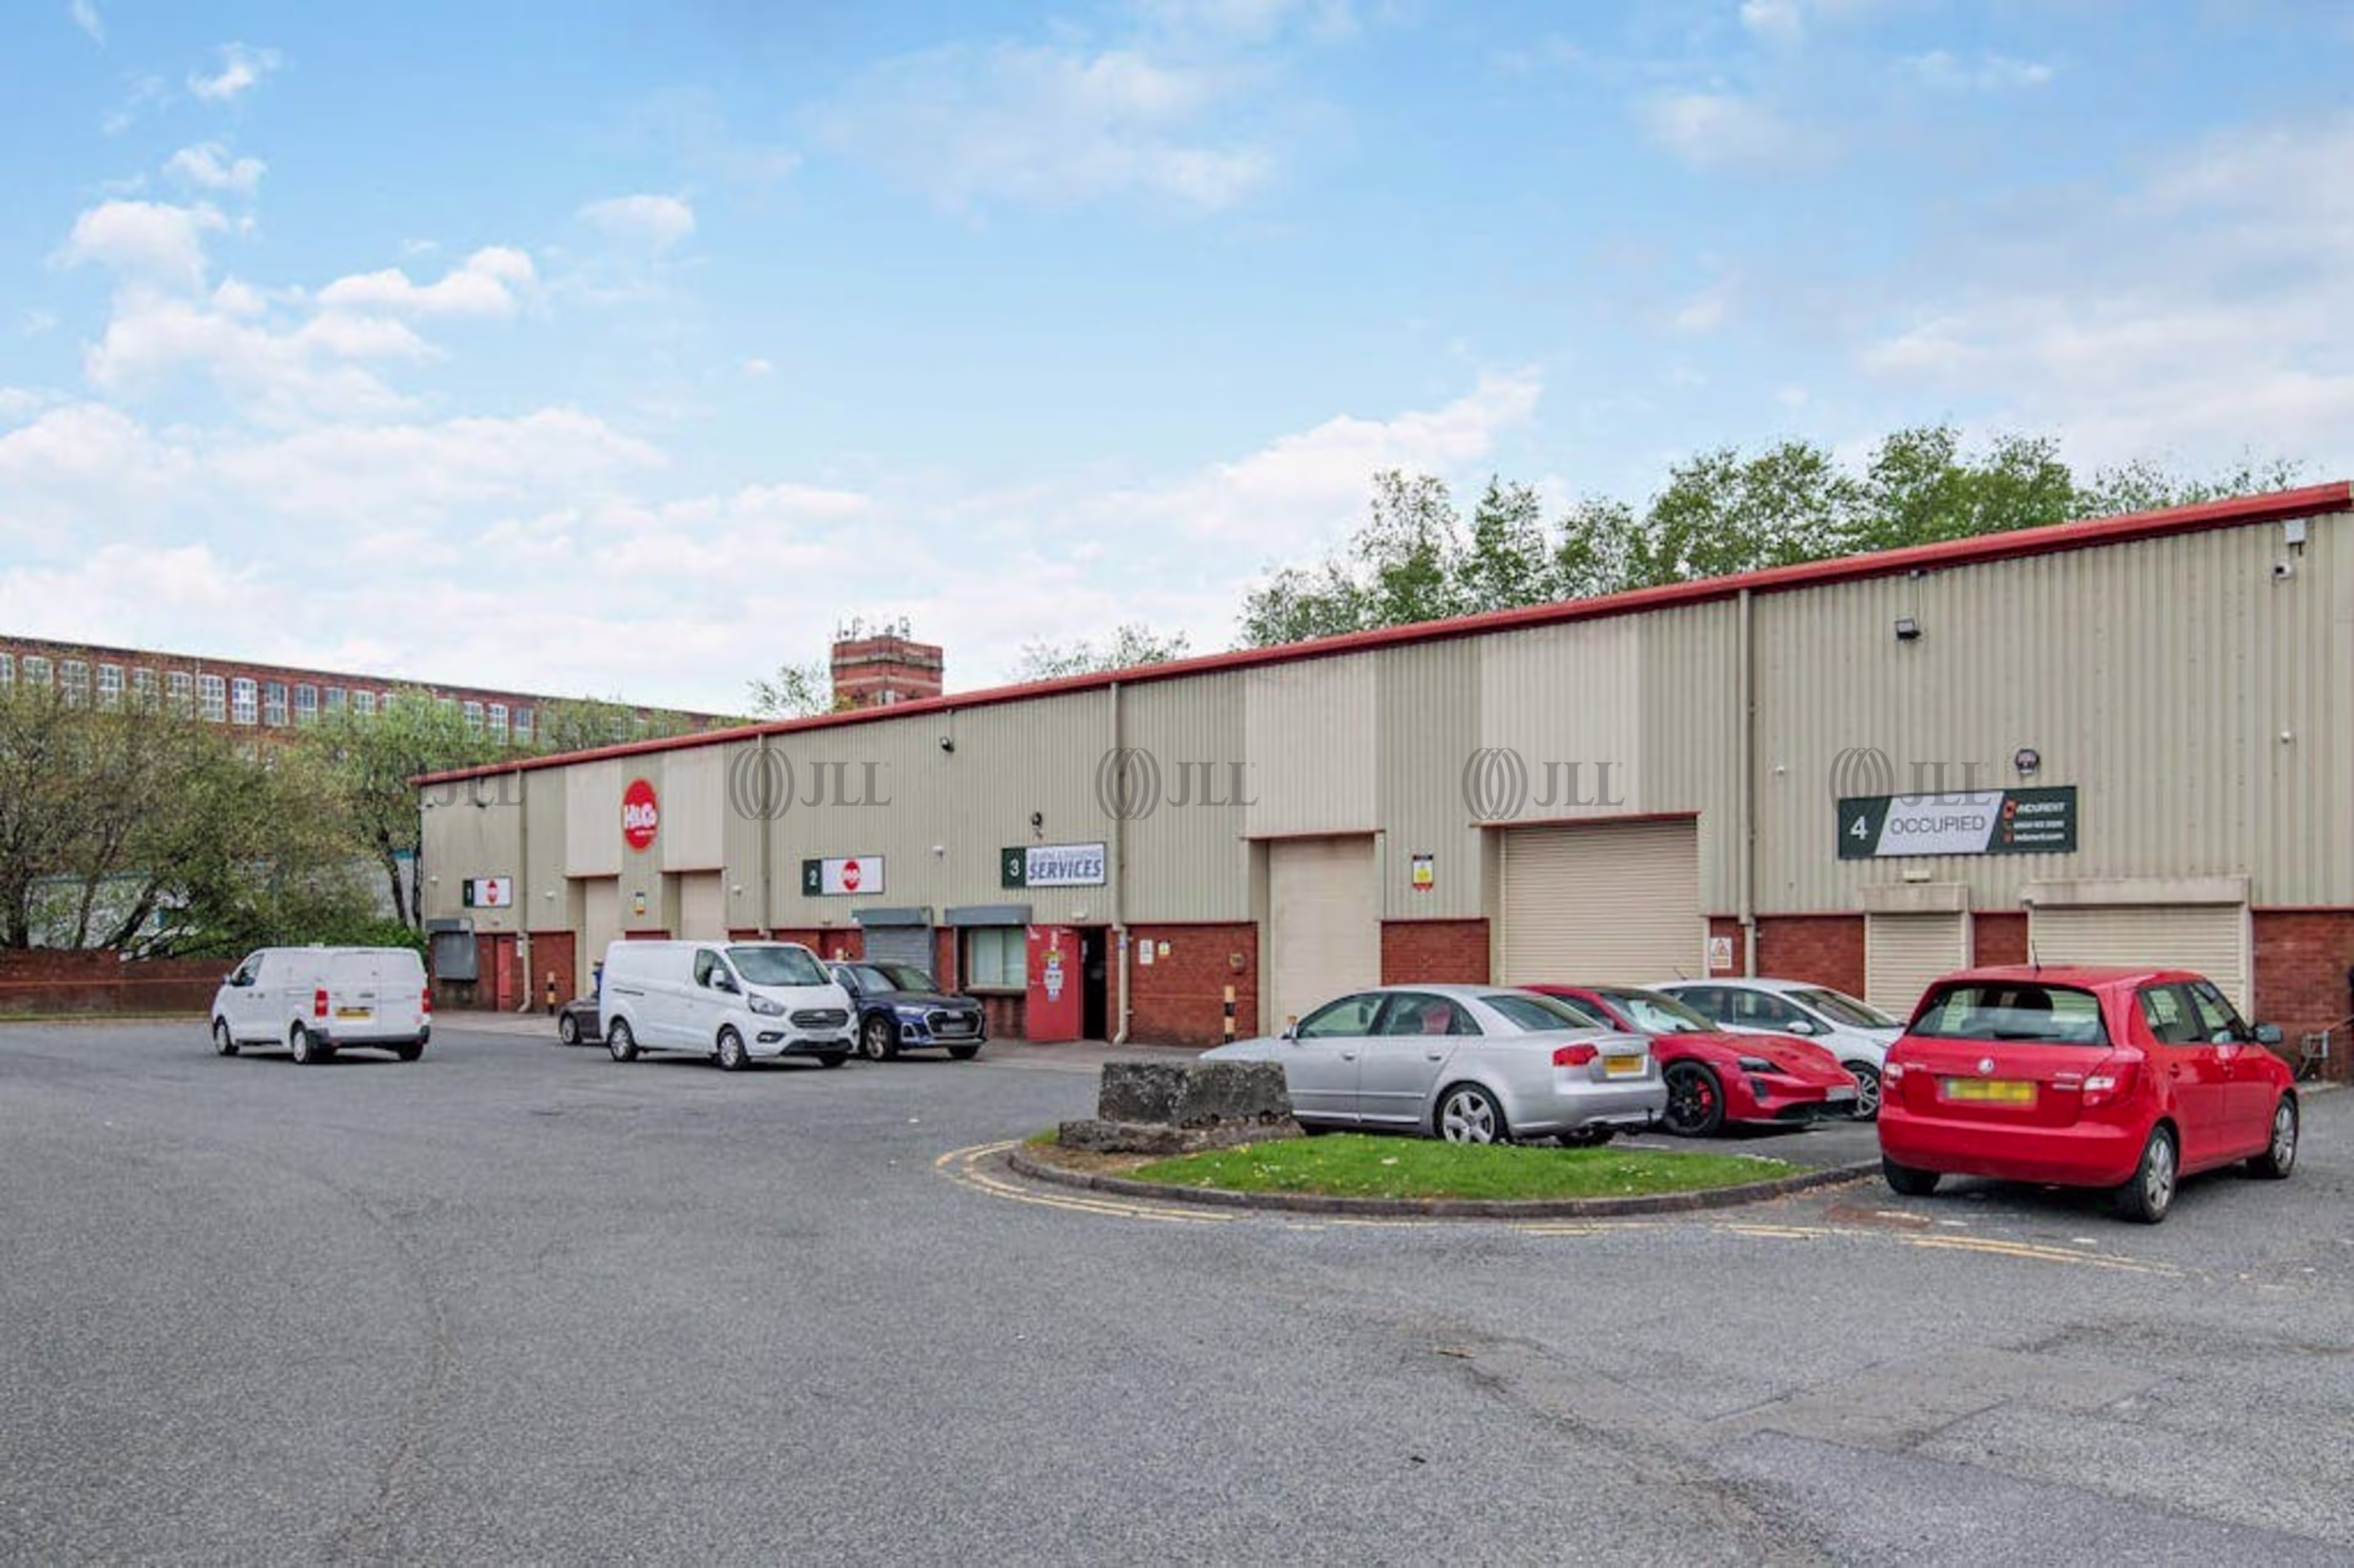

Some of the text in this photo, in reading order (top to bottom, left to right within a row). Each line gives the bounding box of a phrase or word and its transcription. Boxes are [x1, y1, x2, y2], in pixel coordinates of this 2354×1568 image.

[1850, 815, 1986, 840] 4 OCCUPIED
[1010, 859, 1019, 877] 3
[1029, 859, 1102, 880] SERVICES
[809, 870, 818, 886] 2
